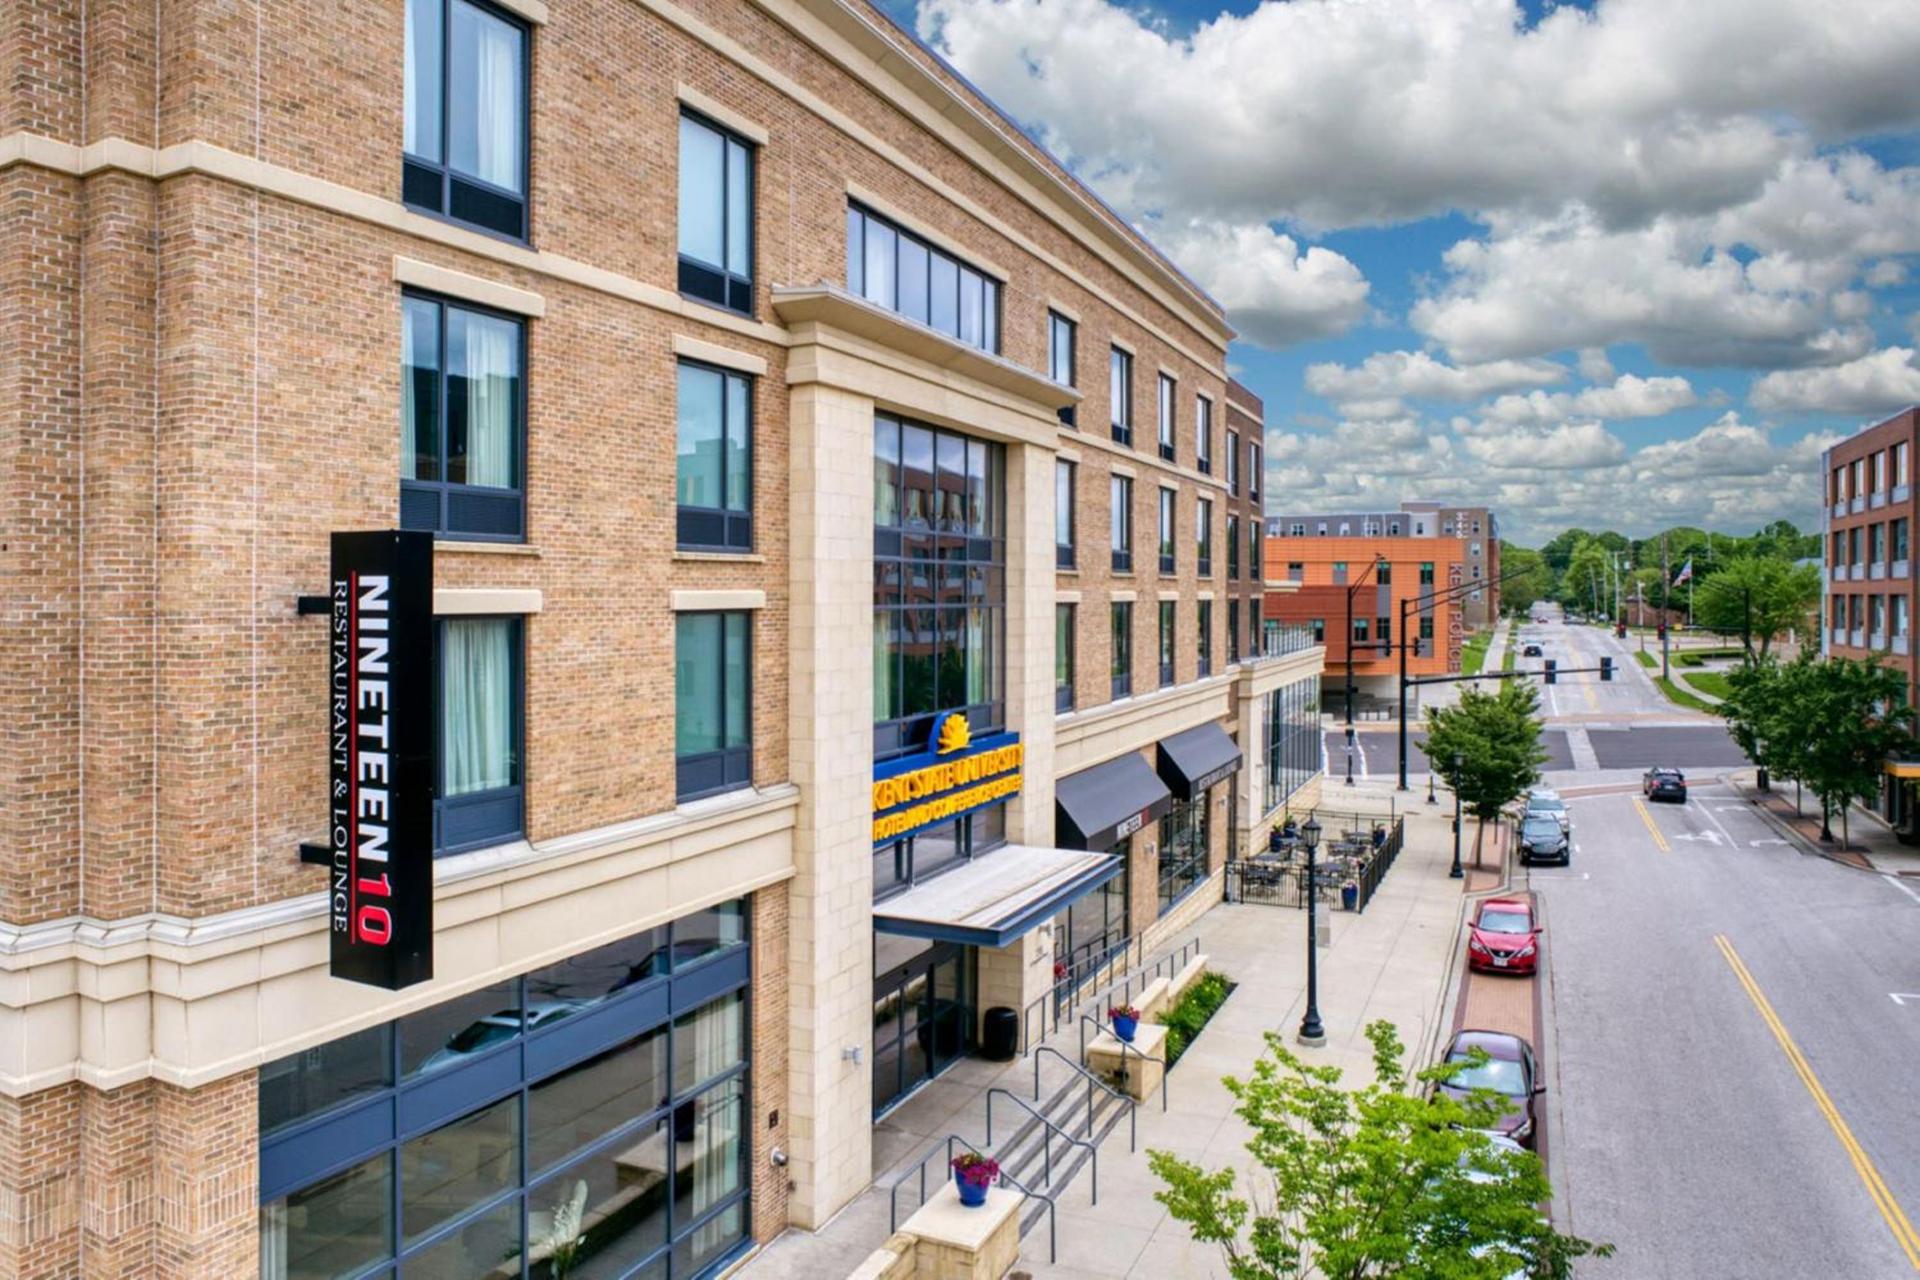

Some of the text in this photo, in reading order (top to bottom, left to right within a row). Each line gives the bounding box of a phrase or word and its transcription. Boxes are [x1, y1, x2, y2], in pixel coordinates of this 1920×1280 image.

[333, 580, 347, 933] RESTAURANT & LOUNGE
[358, 575, 392, 947] NINETEEN 10
[1448, 563, 1464, 673] KENT POLICE
